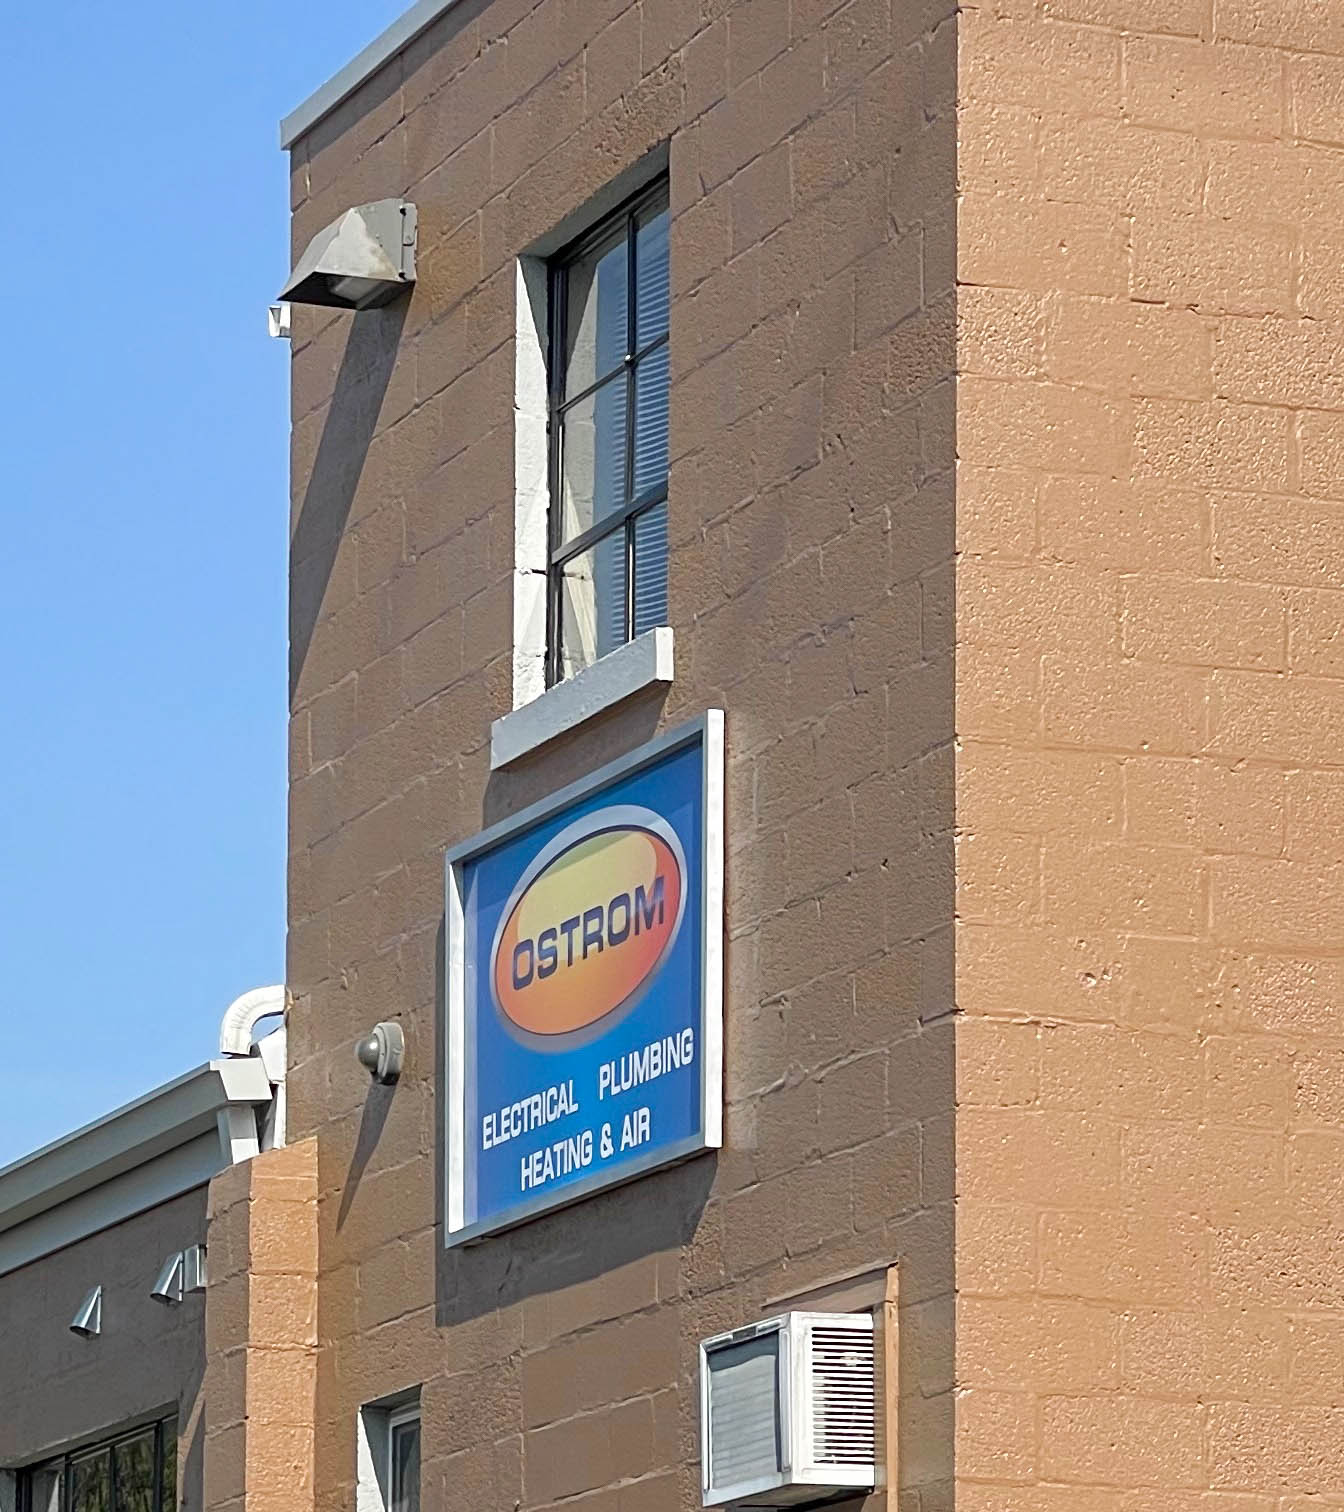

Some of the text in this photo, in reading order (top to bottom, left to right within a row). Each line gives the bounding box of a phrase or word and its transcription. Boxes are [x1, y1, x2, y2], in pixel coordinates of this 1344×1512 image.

[511, 875, 664, 991] OSTROM
[482, 1027, 694, 1150] ELECTRICAL PLUMBING
[521, 1106, 650, 1192] HEATING & AIR
